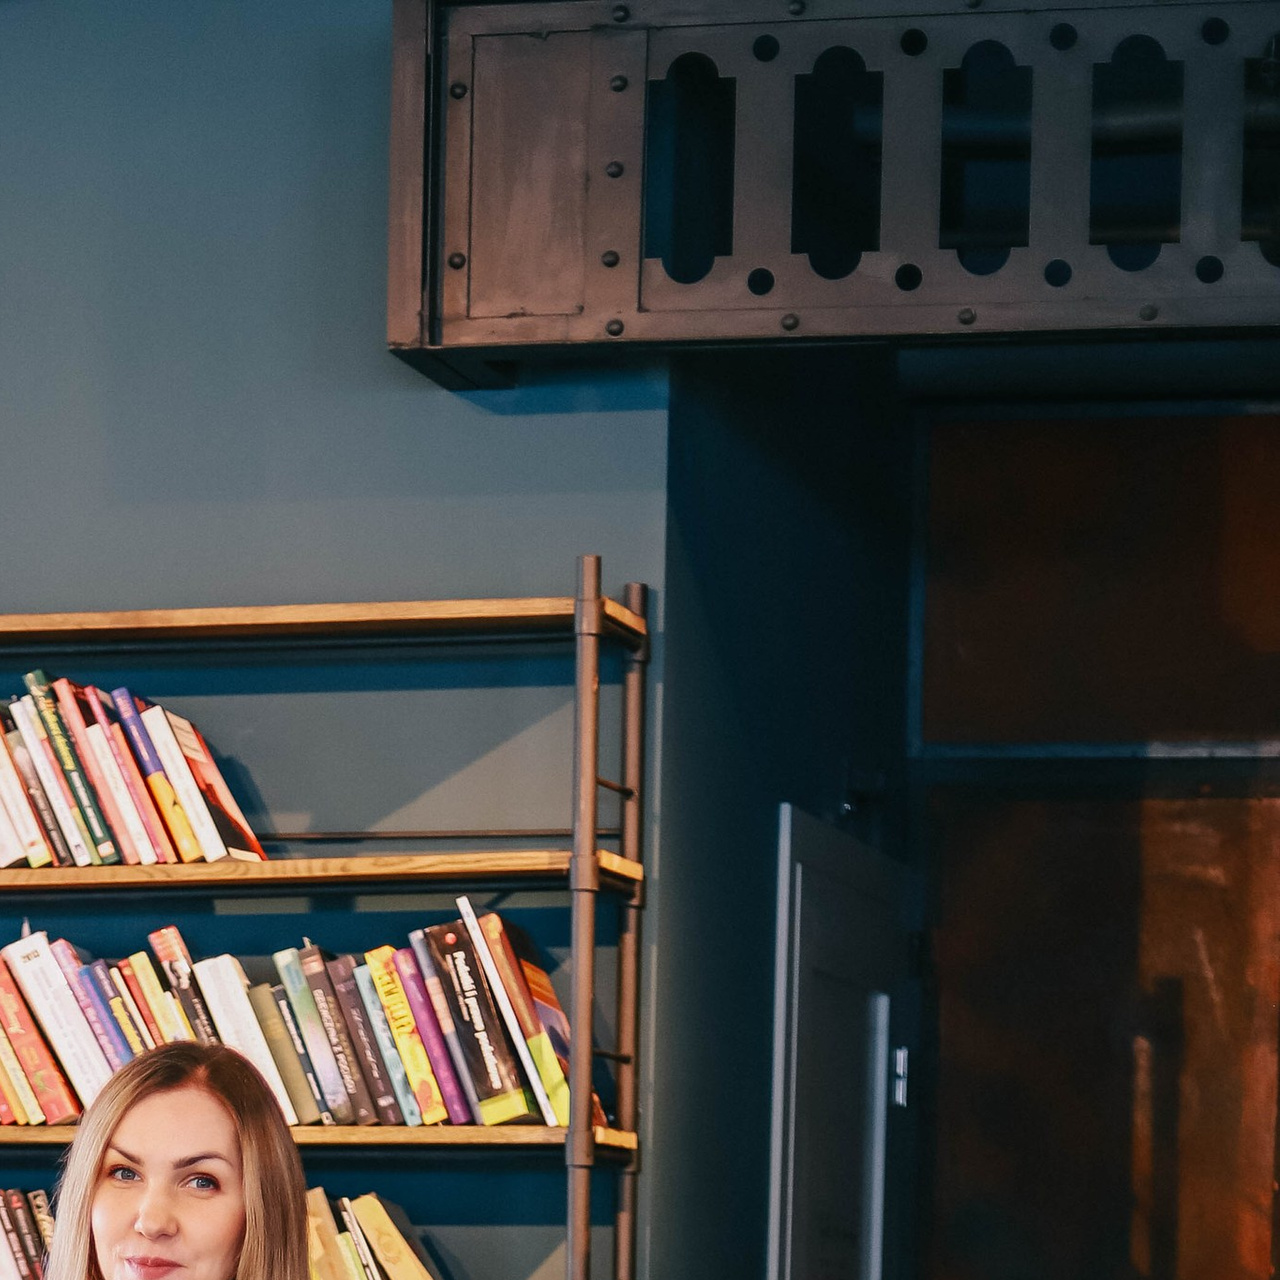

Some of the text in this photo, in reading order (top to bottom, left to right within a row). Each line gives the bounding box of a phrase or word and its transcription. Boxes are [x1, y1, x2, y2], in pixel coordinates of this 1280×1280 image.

[453, 950, 475, 989] Podatki
[465, 996, 485, 1031] prawo
[475, 1029, 502, 1089] podatkowe
